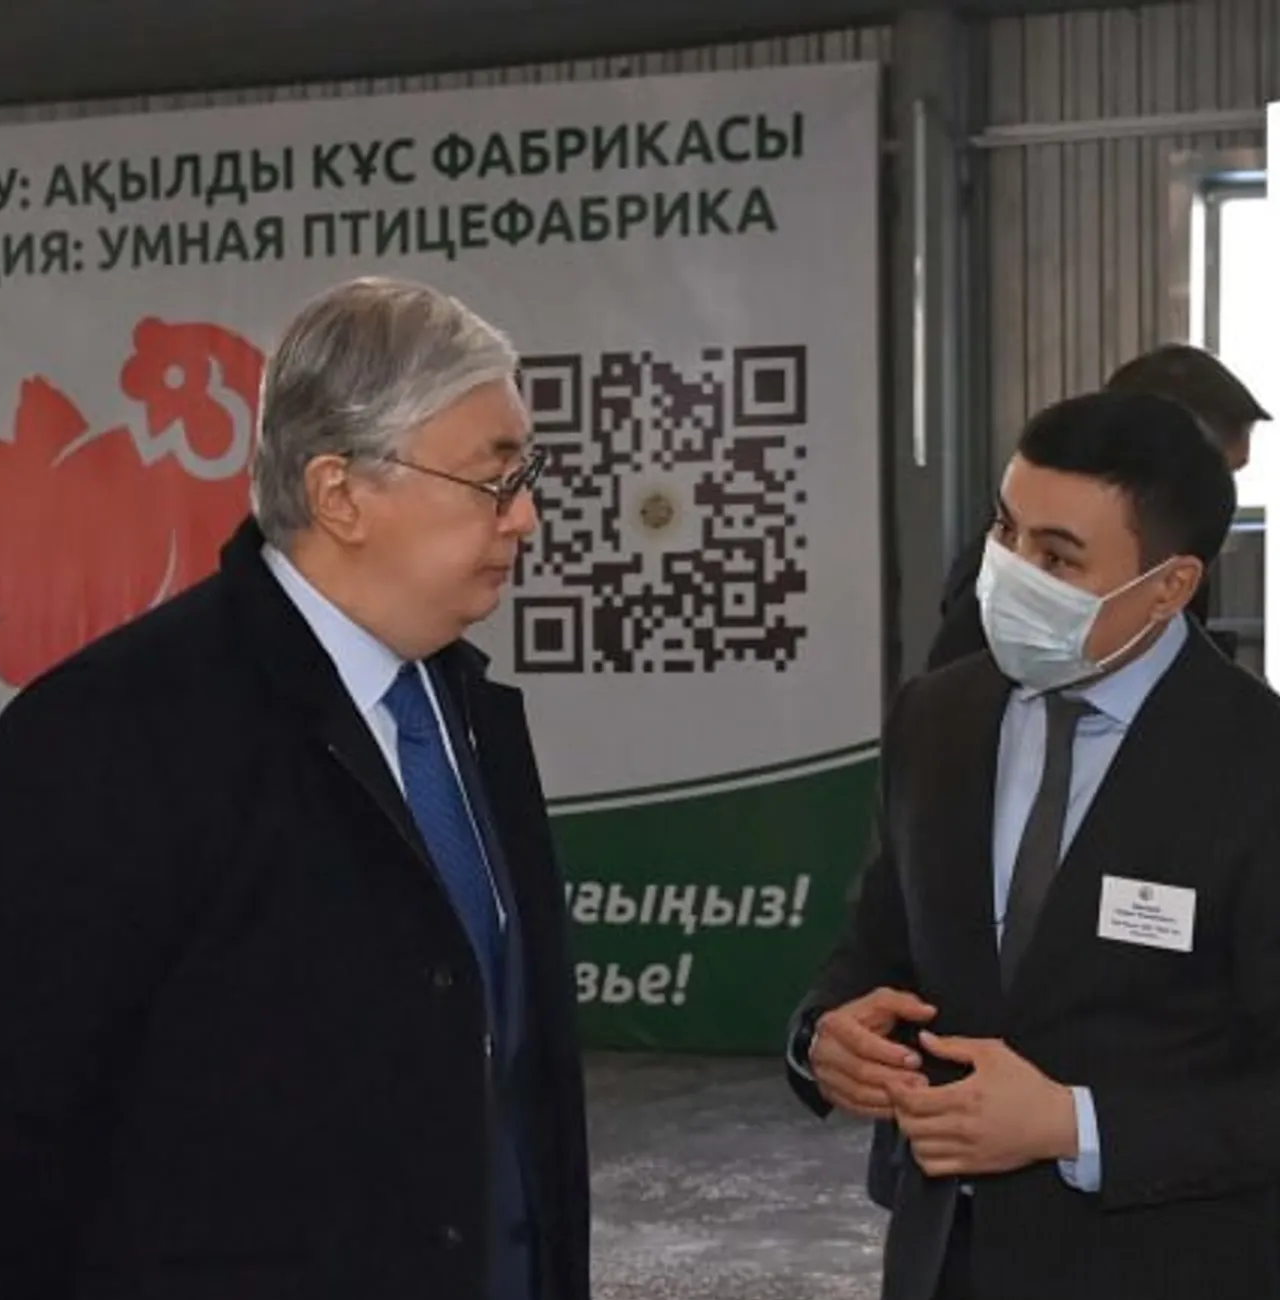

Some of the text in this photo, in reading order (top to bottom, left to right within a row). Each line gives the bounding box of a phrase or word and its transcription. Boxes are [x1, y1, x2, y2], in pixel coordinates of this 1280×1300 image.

[44, 145, 293, 213] АҚЫЛДЫ
[312, 138, 416, 190] КҰС
[431, 112, 805, 182] ФАБРИКАСЫ
[97, 216, 285, 271] УМНАЯ
[303, 187, 778, 261] ПТИЦЕФАБРИКА
[565, 873, 811, 936] ғыңыз!
[575, 953, 693, 1006] вье!
